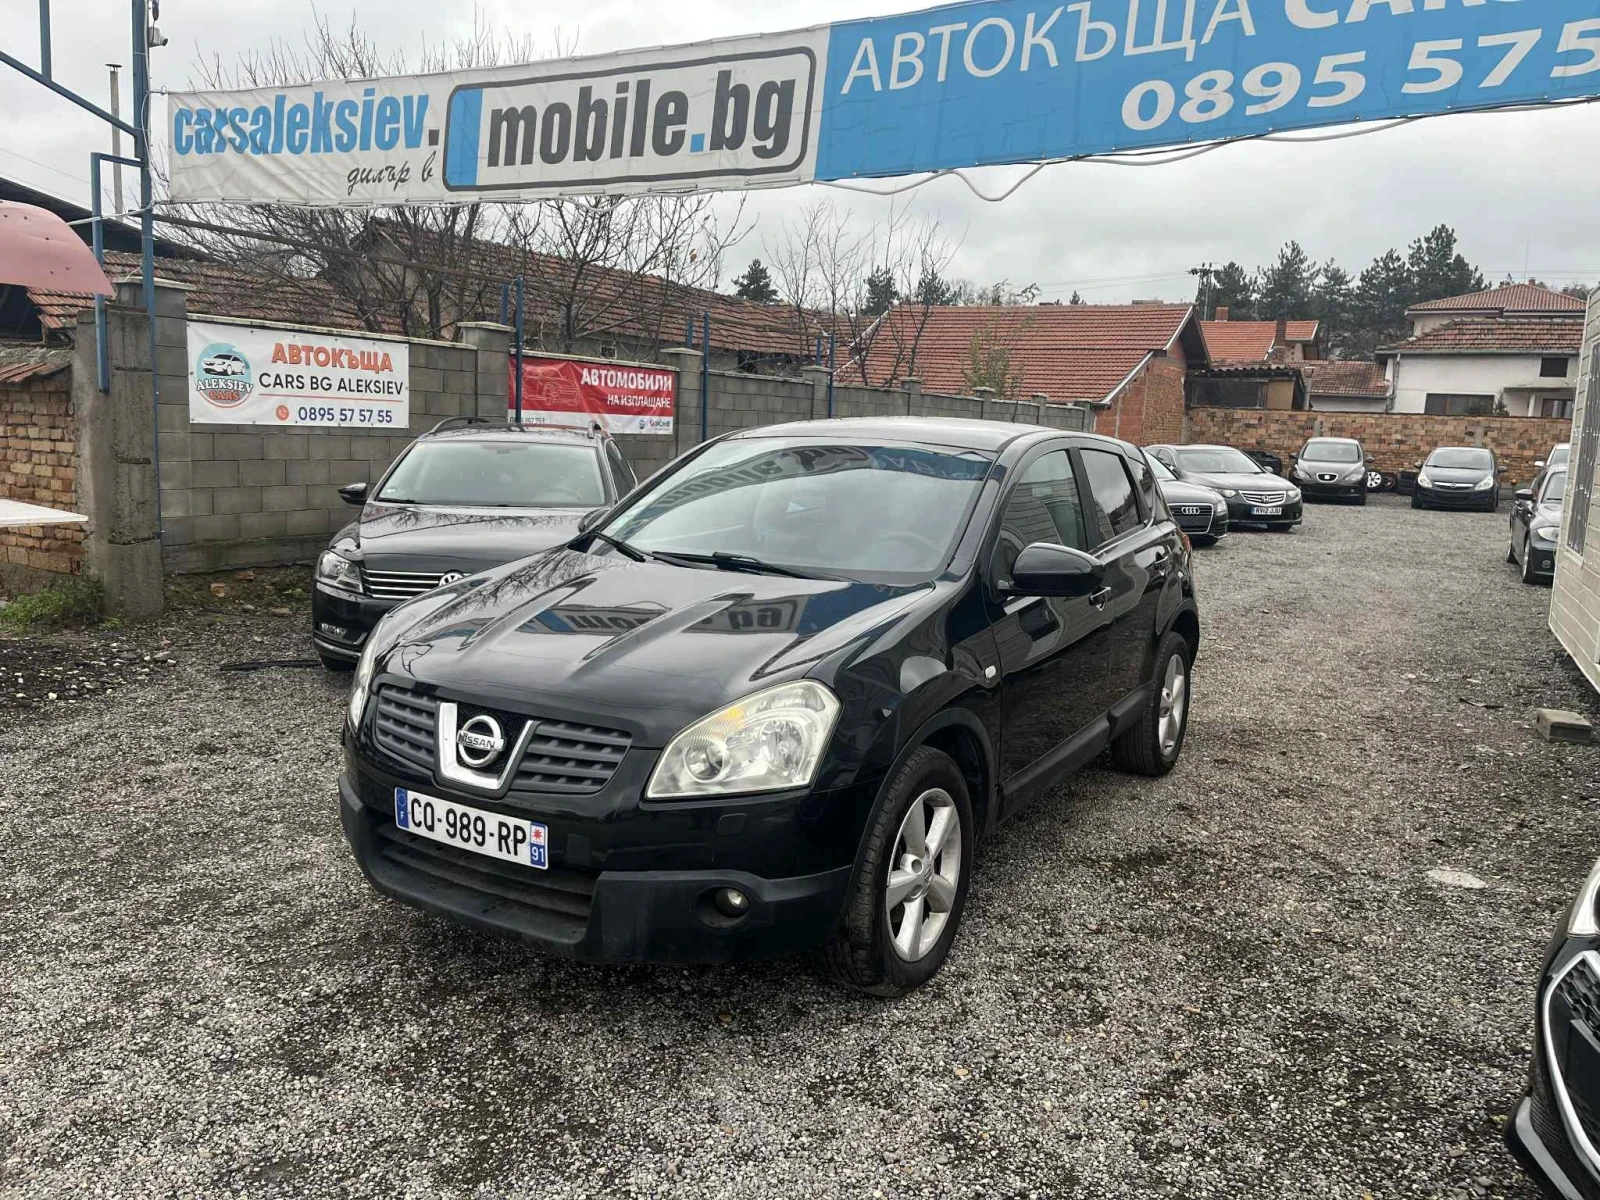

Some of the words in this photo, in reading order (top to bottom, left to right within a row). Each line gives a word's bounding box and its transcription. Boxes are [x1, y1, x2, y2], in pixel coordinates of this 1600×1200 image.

[1121, 51, 1366, 131] 0895
[487, 69, 797, 167] mobile.bg
[271, 343, 394, 374] АВТОКЪЩА
[196, 378, 254, 393] ALEKSIEV
[258, 372, 305, 390] CARS
[310, 375, 332, 391] BG
[337, 378, 404, 395] ALEKSIEV
[581, 368, 673, 391] АВТОМОБИЛИ
[209, 389, 240, 401] CARS
[607, 393, 620, 406] НА
[621, 394, 671, 410] ИЗПЛАЩАНЕ
[298, 406, 335, 421] 0895
[339, 408, 355, 422] 57
[359, 408, 374, 423] 57
[377, 409, 393, 423] 55
[458, 732, 496, 748] NISSAN
[410, 798, 527, 856] CQ-989-RP
[531, 846, 546, 863] 91
